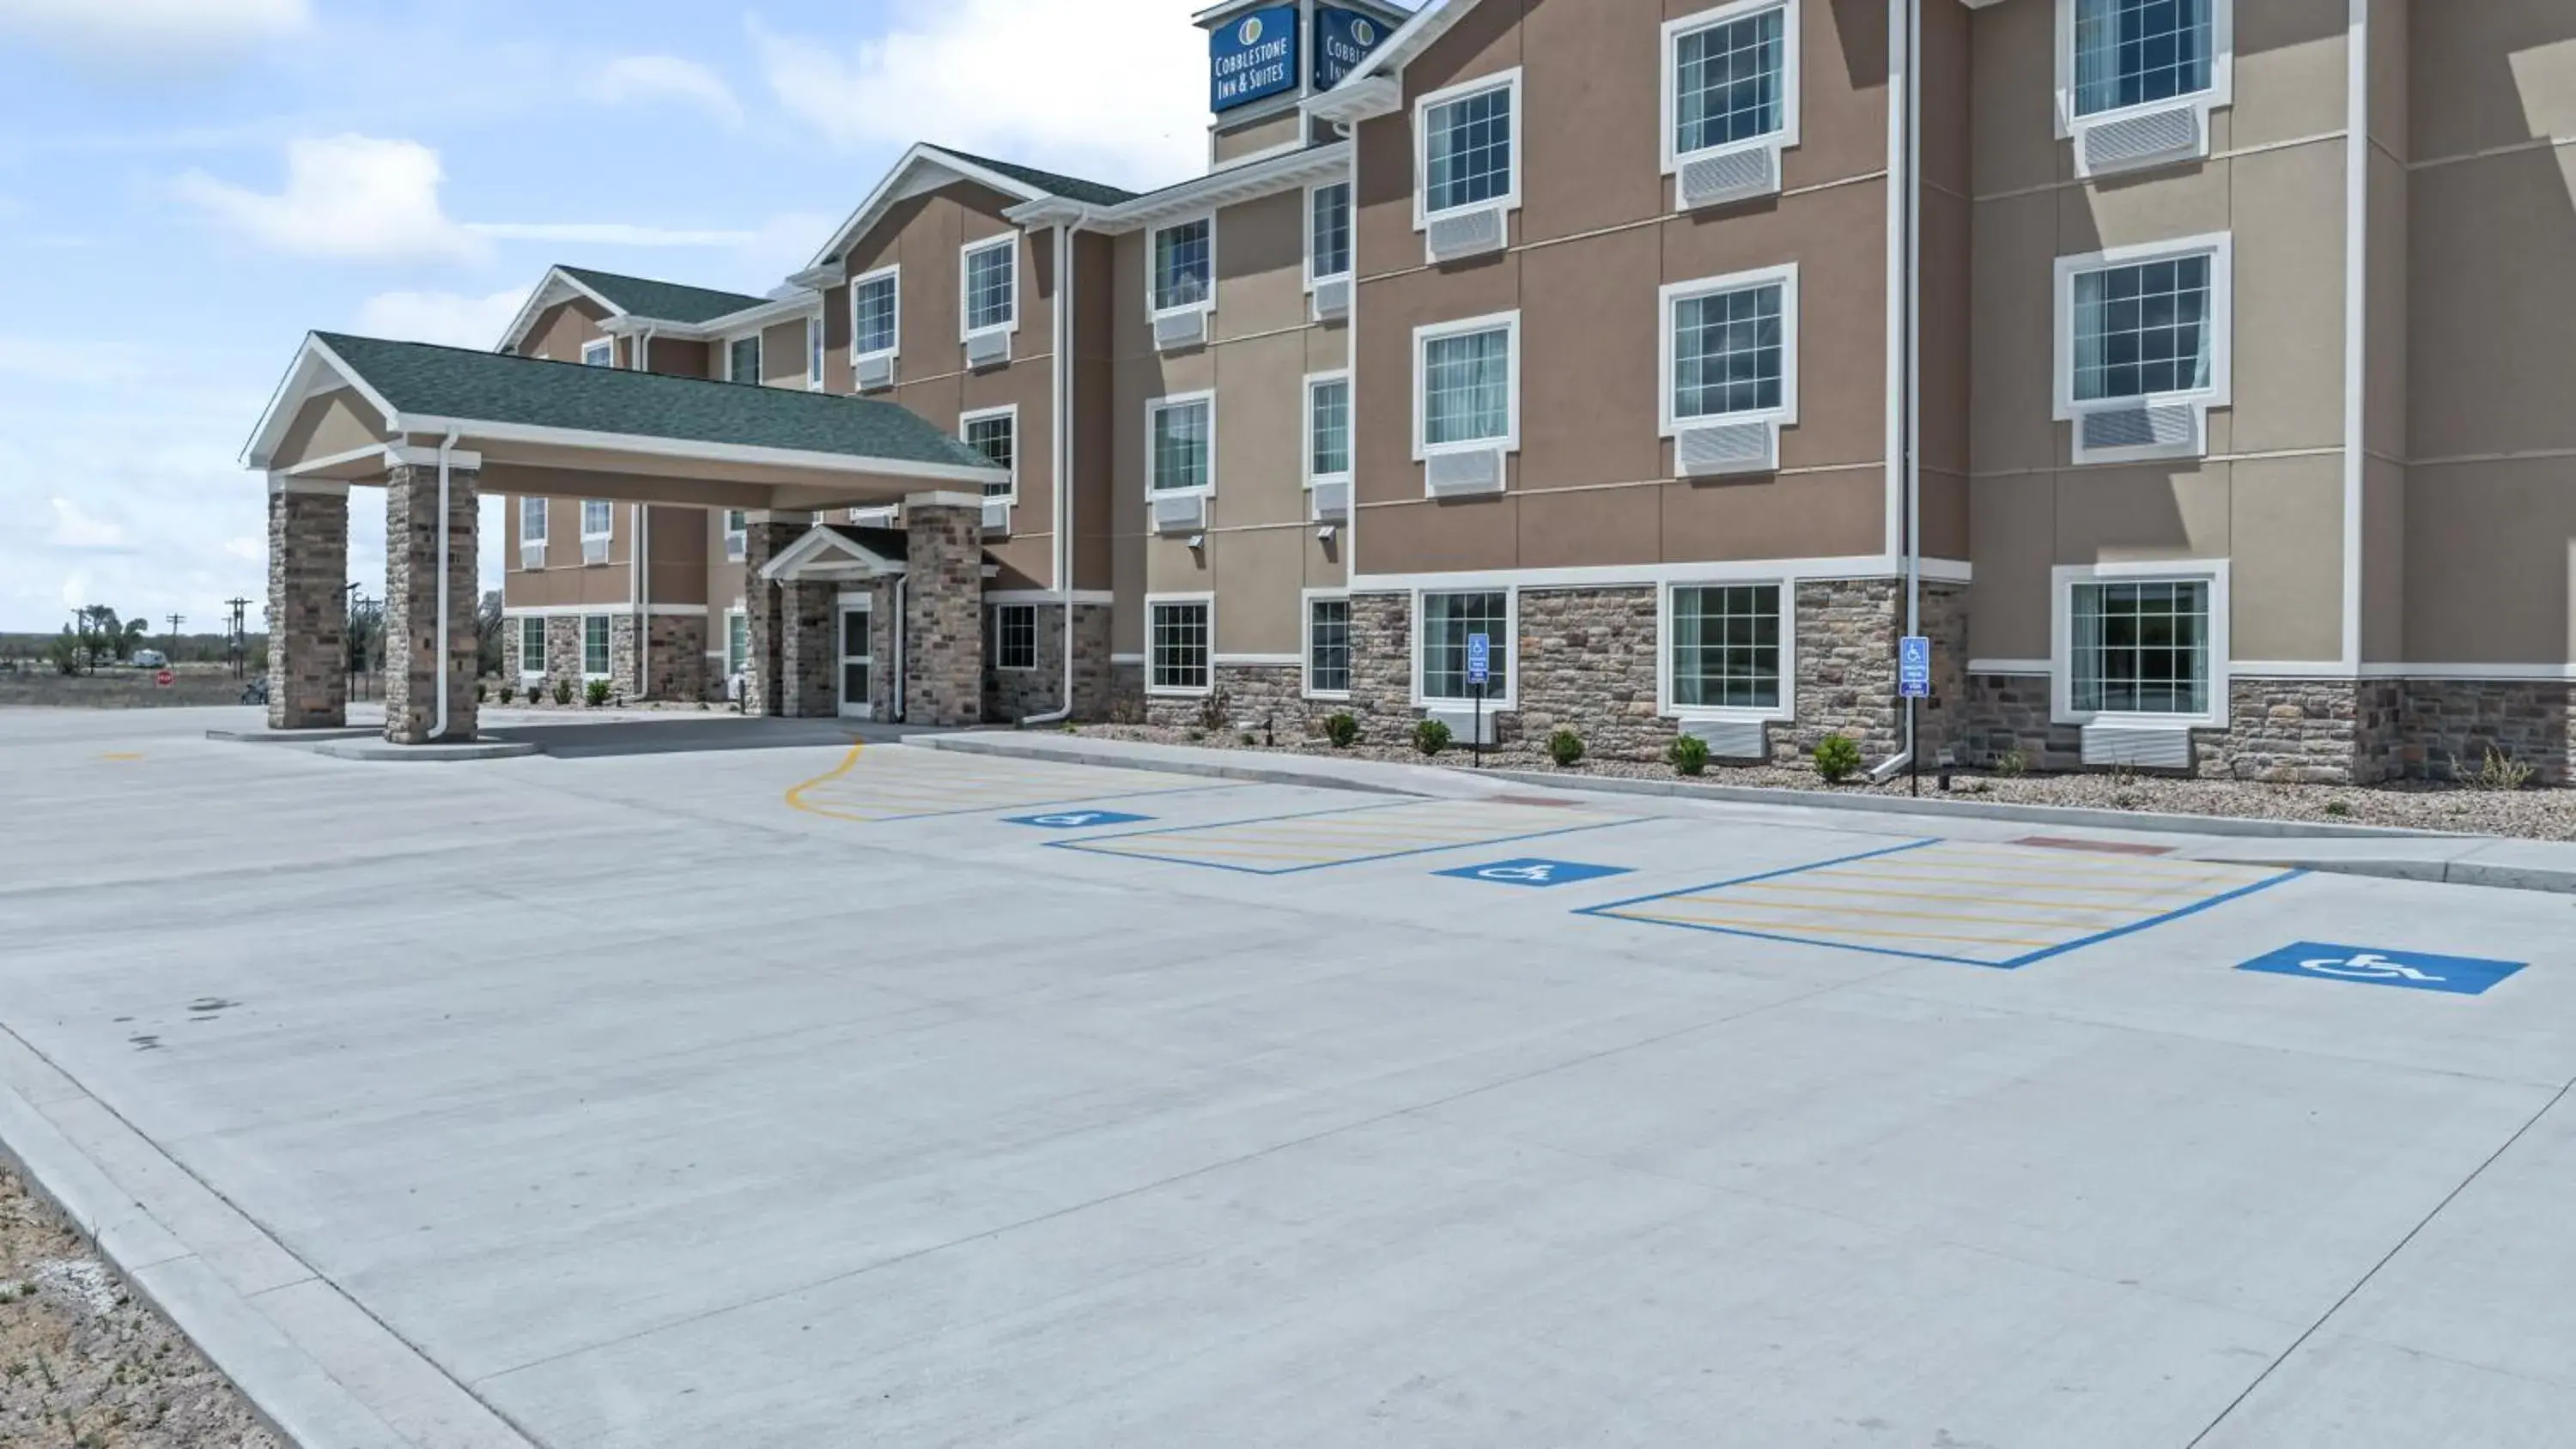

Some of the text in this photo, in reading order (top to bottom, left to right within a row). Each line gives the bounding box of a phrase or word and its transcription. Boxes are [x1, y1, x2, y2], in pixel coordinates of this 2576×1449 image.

[1215, 37, 1287, 77] COBBLESTONE
[1218, 63, 1284, 100] INN & SUITES
